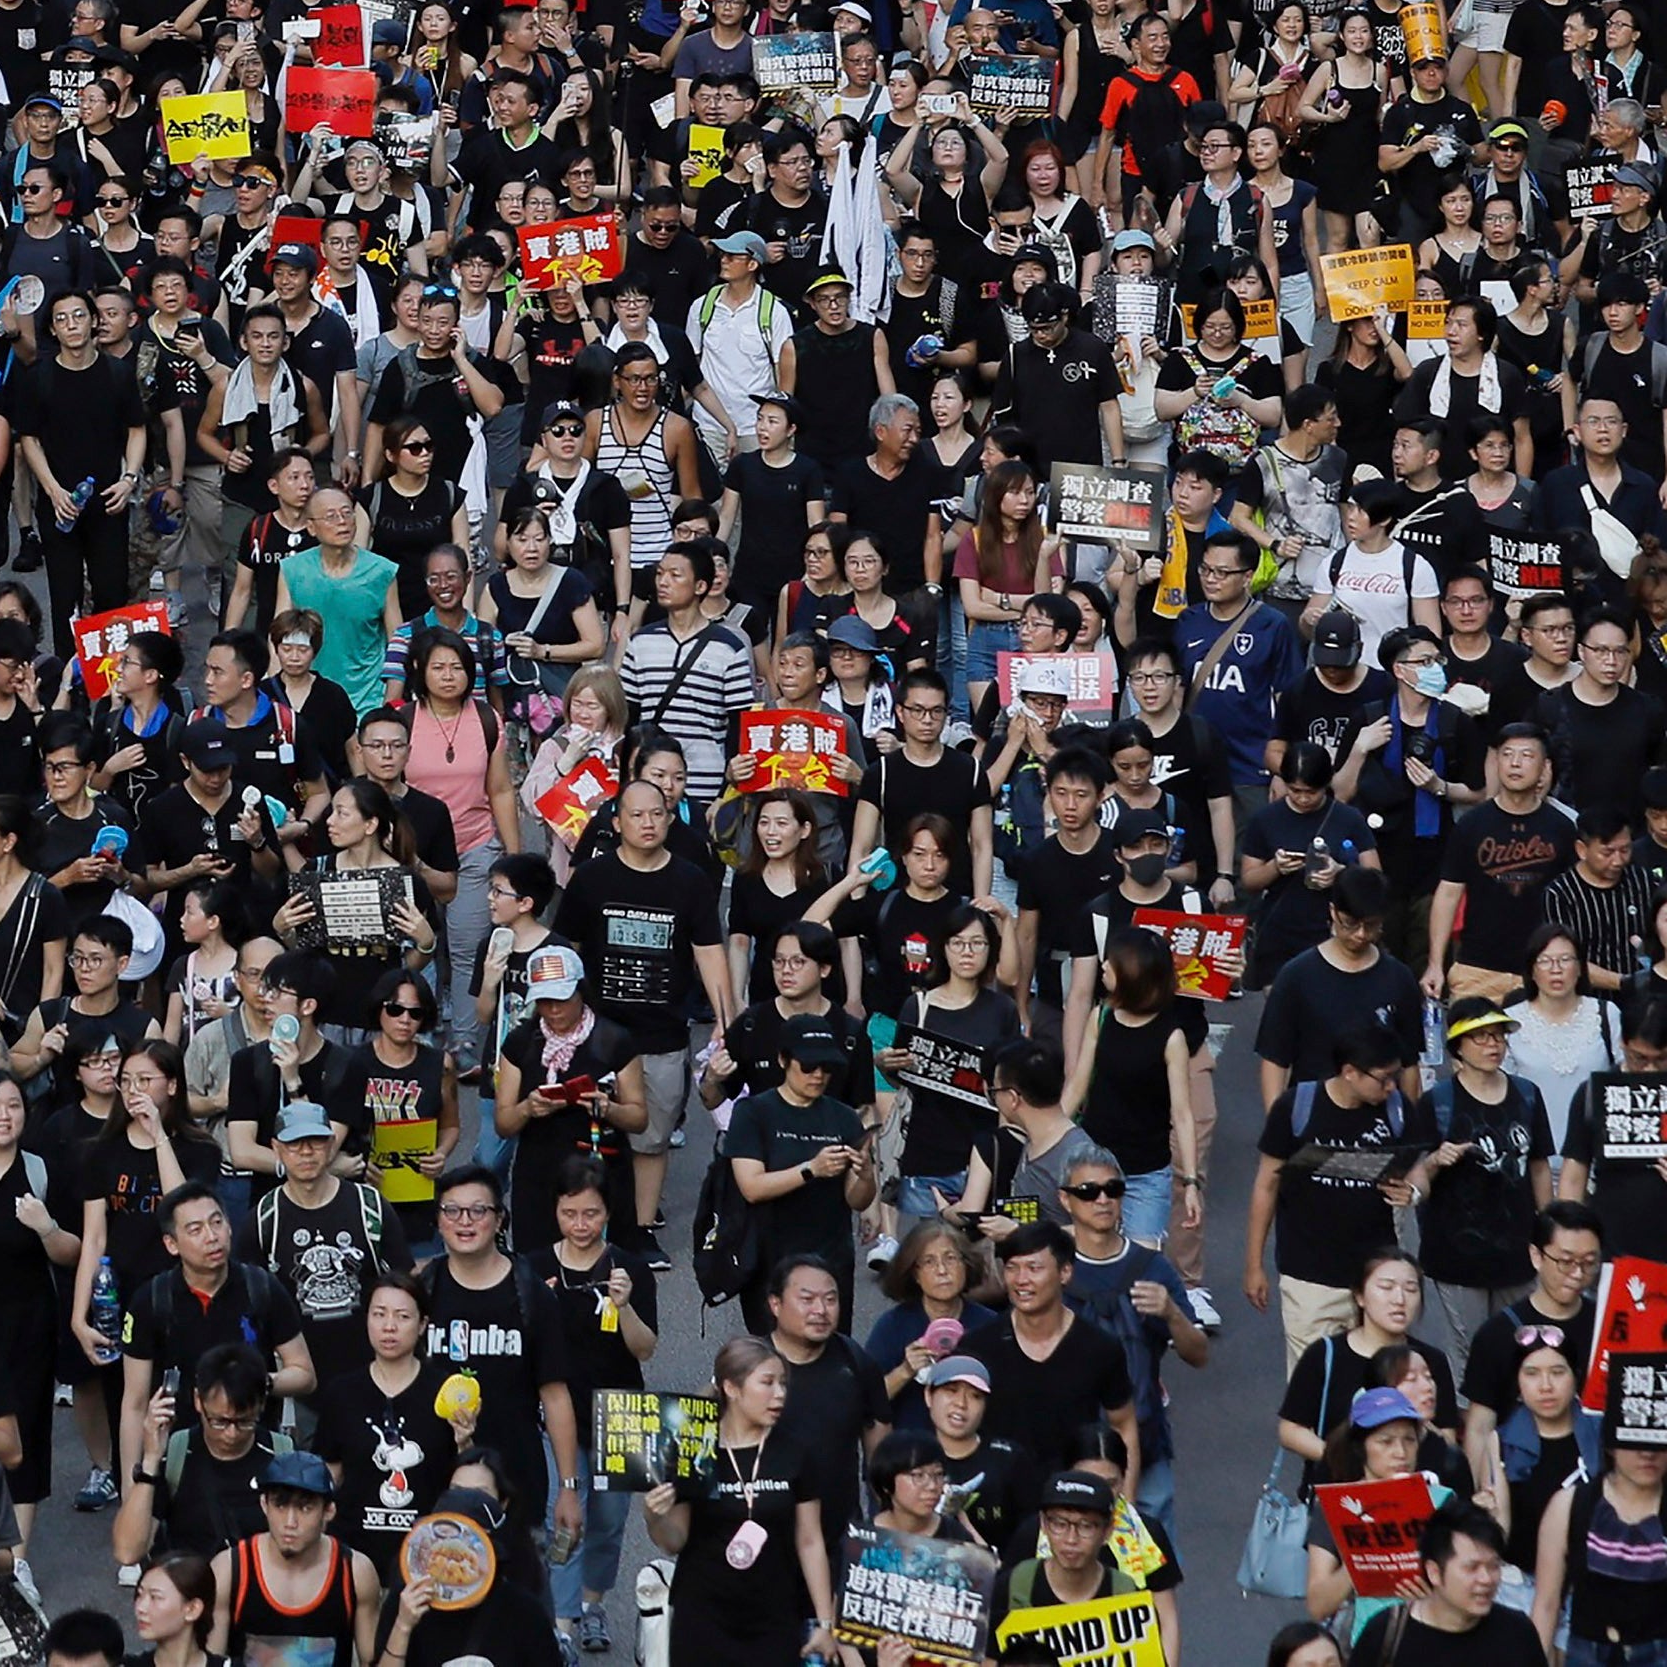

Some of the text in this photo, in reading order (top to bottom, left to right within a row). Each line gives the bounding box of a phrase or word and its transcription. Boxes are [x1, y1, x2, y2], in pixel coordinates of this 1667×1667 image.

[529, 232, 609, 261] 賣港賊
[1348, 276, 1398, 290] KEEP CALM
[1062, 475, 1152, 503] 獨立調查
[1491, 535, 1561, 566] 獨立調查
[1336, 570, 1402, 596] Coca-Cola
[749, 724, 828, 754] 賣港賊
[1477, 833, 1555, 867] Orioles
[627, 910, 649, 918] DATA
[426, 1324, 523, 1357] jr. nba
[1055, 1480, 1096, 1494] Supreme
[364, 1511, 389, 1526] JOE
[1111, 1606, 1152, 1642] UP
